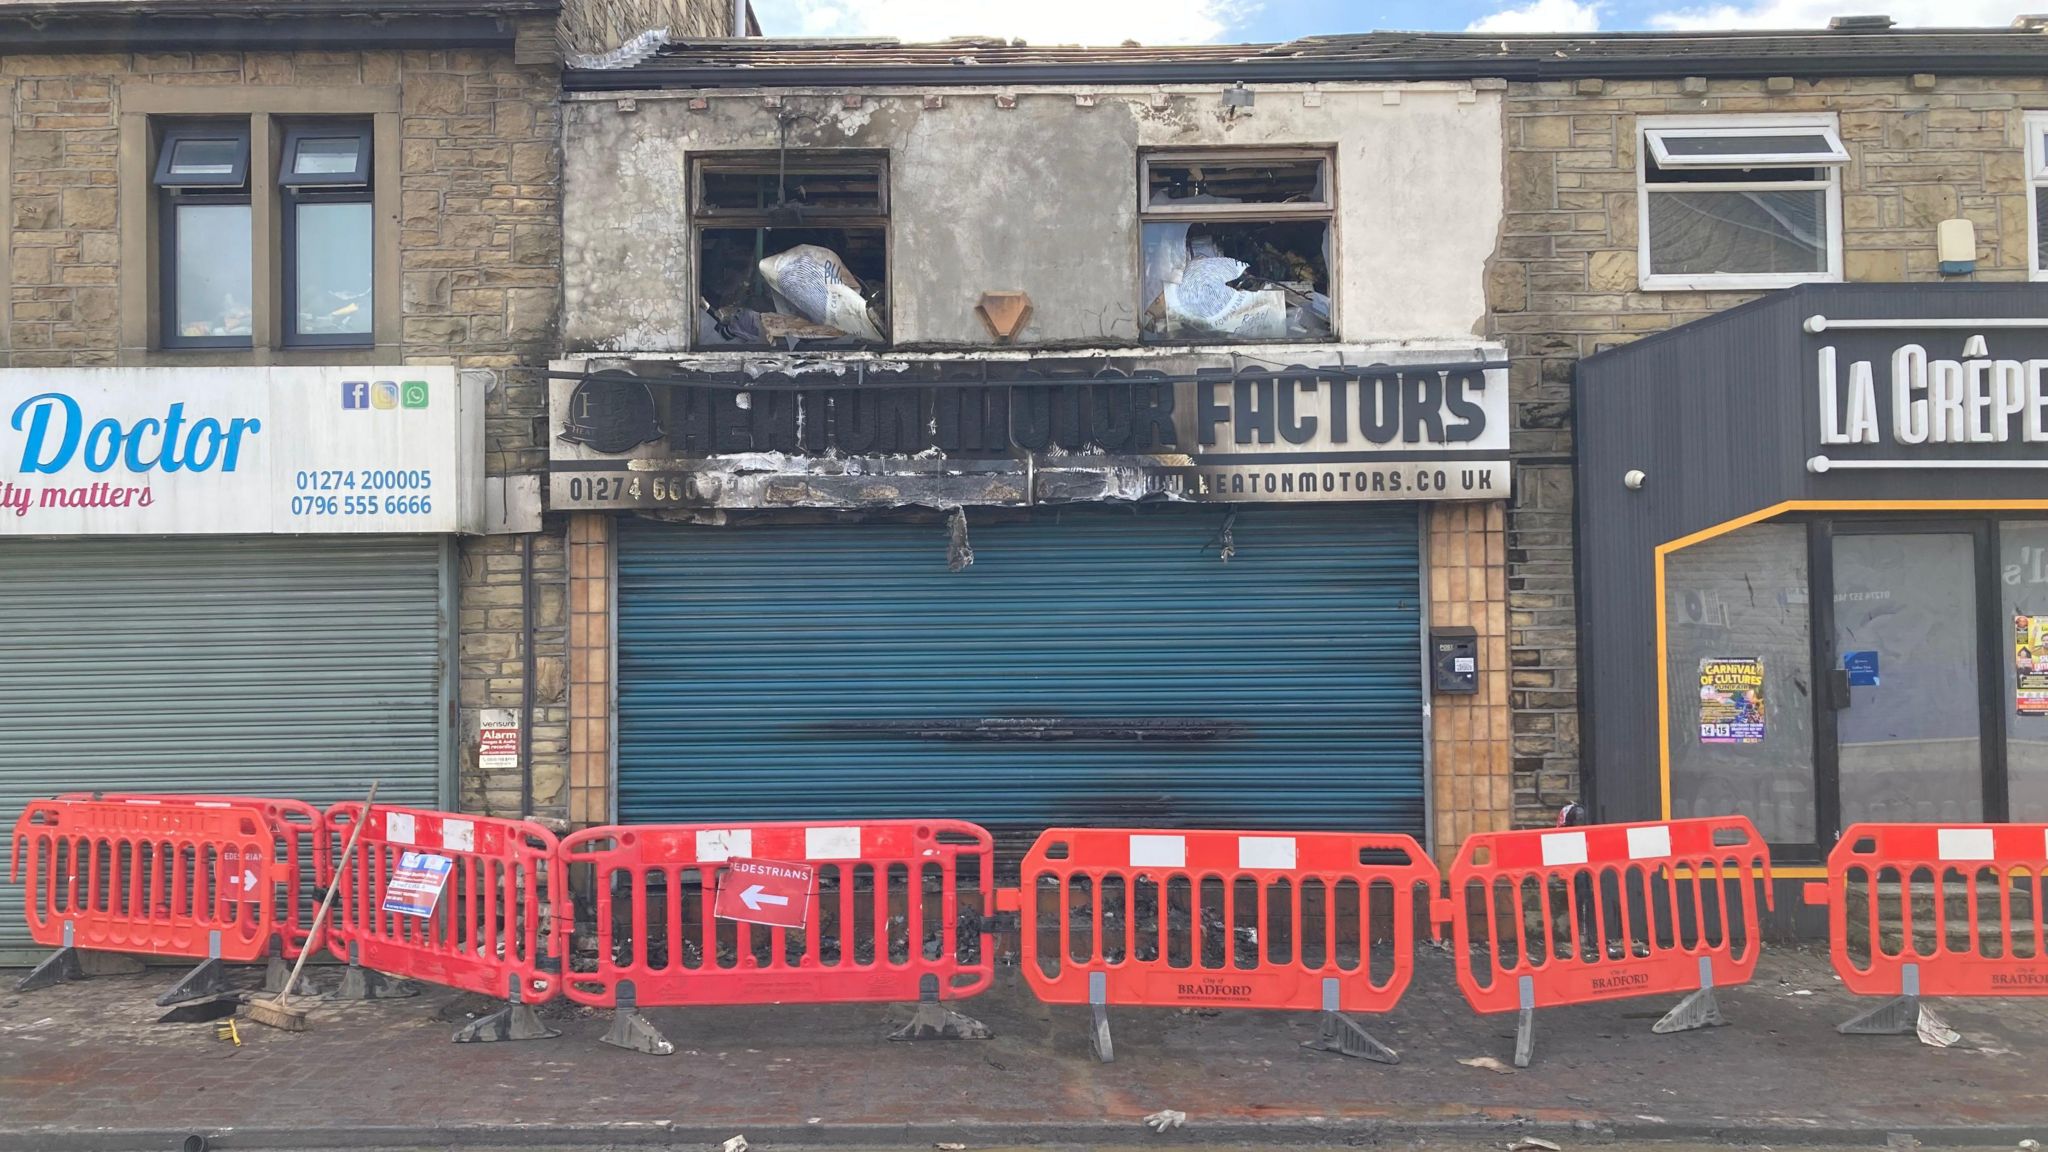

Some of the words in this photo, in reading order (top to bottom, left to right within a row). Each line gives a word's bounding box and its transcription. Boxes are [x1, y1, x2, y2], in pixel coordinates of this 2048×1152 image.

[1197, 364, 1486, 444] FACTORS
[1818, 346, 1880, 444] LA
[11, 393, 261, 474] Doctor
[297, 470, 355, 490] 01274
[361, 470, 431, 489] 200005
[1461, 470, 1492, 490] UK
[40, 482, 155, 507] matters
[291, 495, 338, 515] 0796
[344, 495, 378, 515] 555
[385, 495, 432, 515] 6666
[1700, 675, 1713, 685] OF
[1715, 674, 1762, 685] CULTURES
[483, 730, 517, 739] Alarm
[1178, 984, 1252, 995] BRADFORD
[1592, 973, 1649, 990] BRADFORD
